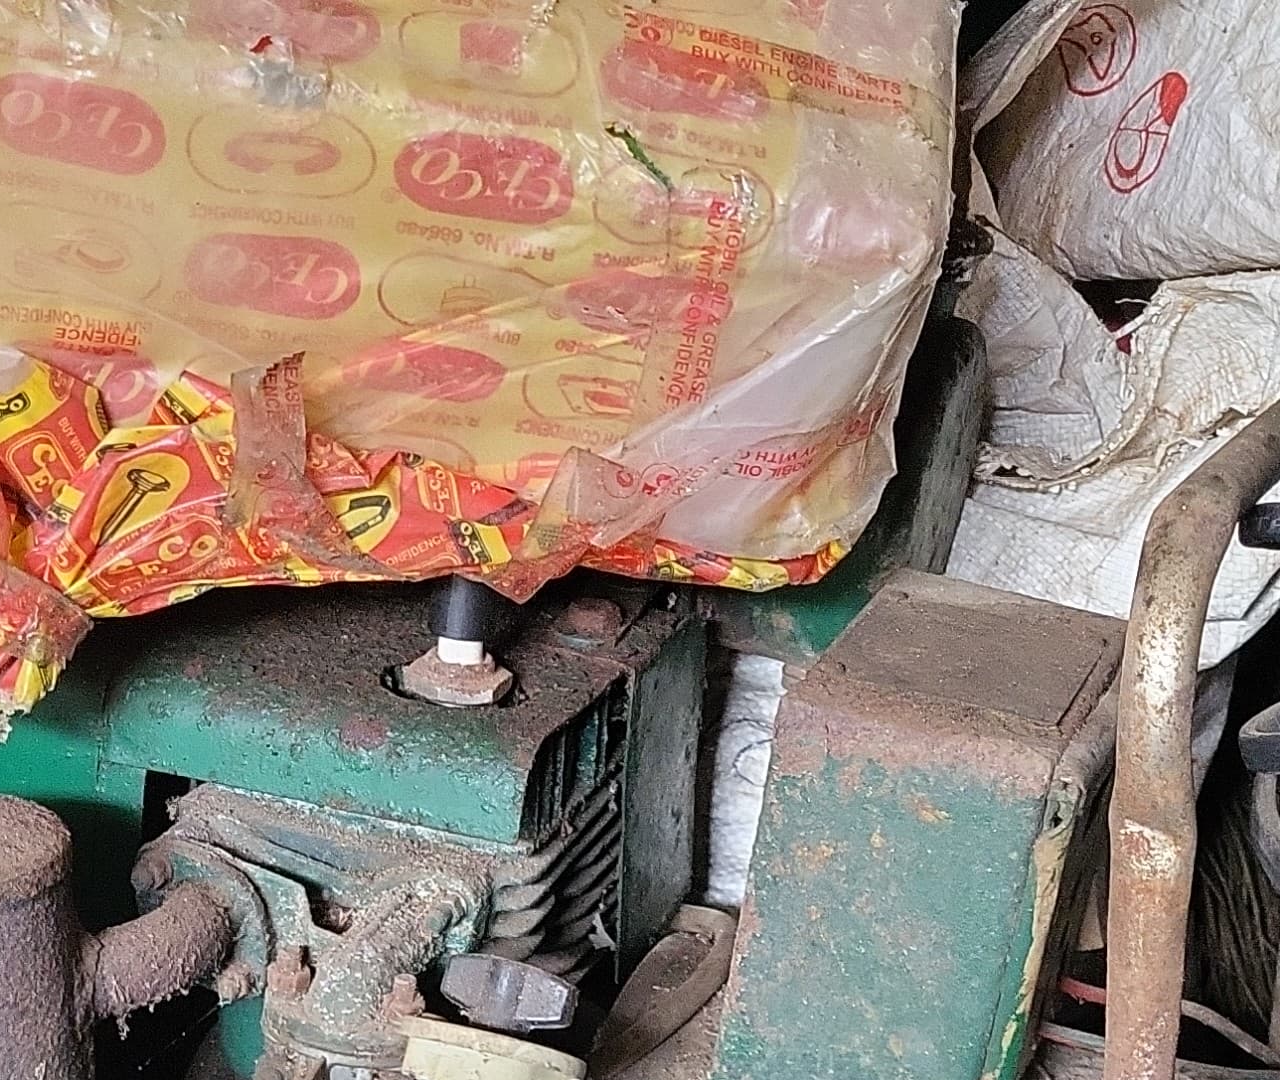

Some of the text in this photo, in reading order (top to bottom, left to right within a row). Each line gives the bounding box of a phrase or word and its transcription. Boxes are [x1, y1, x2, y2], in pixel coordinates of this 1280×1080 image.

[691, 45, 730, 64] BUY
[735, 55, 781, 79] WITH
[700, 28, 766, 57] DIESEL
[770, 49, 838, 78] ENGINE
[0, 90, 153, 158] CECO
[410, 148, 560, 212] CECO
[704, 200, 723, 242] BUY
[695, 243, 715, 288] WITH
[709, 277, 729, 309] OIL
[666, 292, 700, 406] CONFIDENCE
[688, 334, 716, 404] GREASE
[733, 463, 762, 477] OIL
